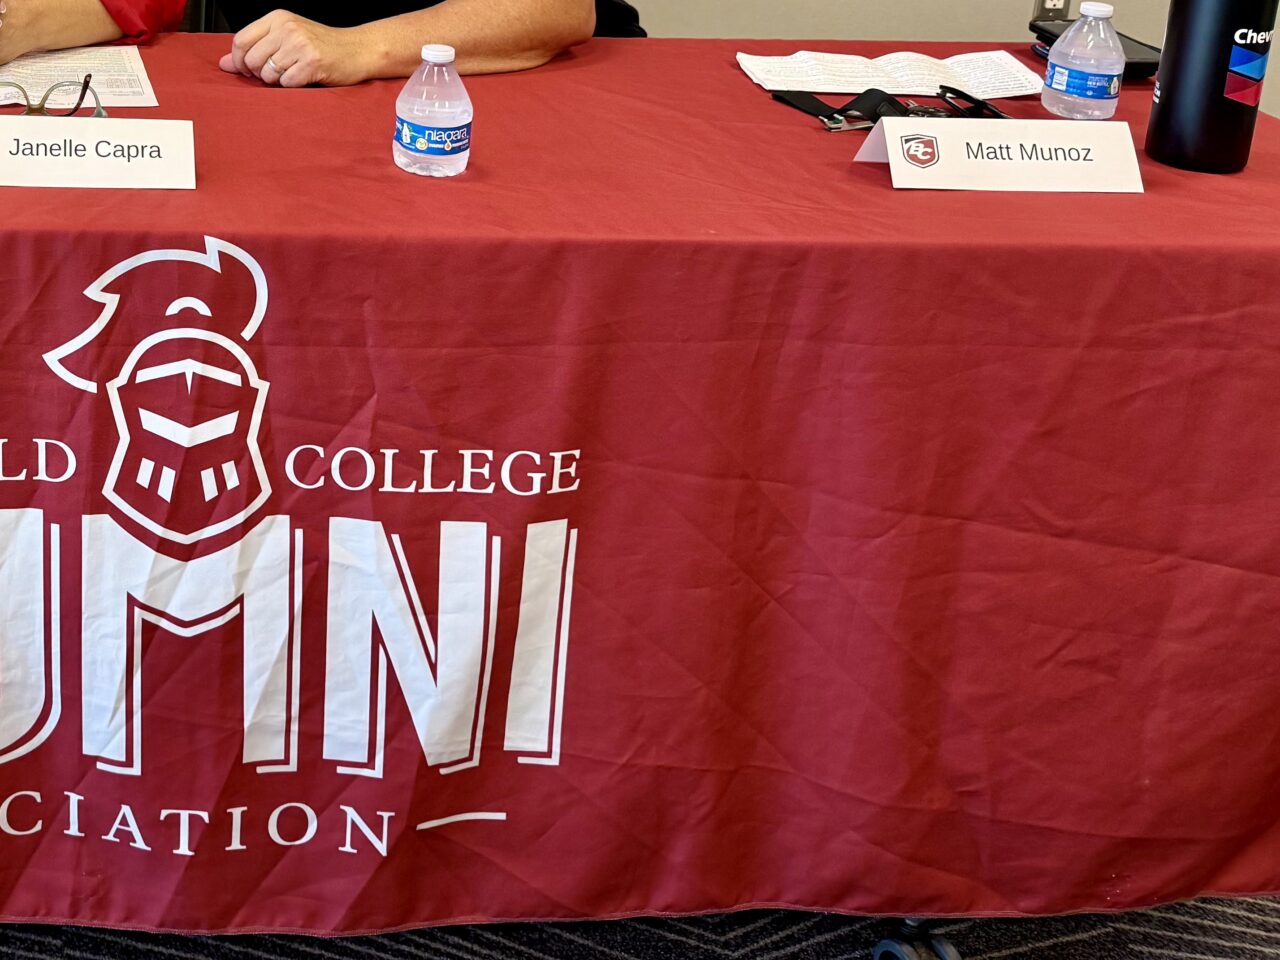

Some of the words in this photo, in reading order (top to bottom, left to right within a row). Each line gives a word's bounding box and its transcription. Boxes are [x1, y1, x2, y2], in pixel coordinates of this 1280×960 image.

[1234, 28, 1274, 44] Chev
[425, 128, 467, 141] niagara
[9, 138, 87, 157] Janelle
[95, 140, 162, 162] Capra
[966, 142, 1013, 161] Matt
[1019, 143, 1094, 163] Munoz
[286, 445, 582, 495] COLLEGE
